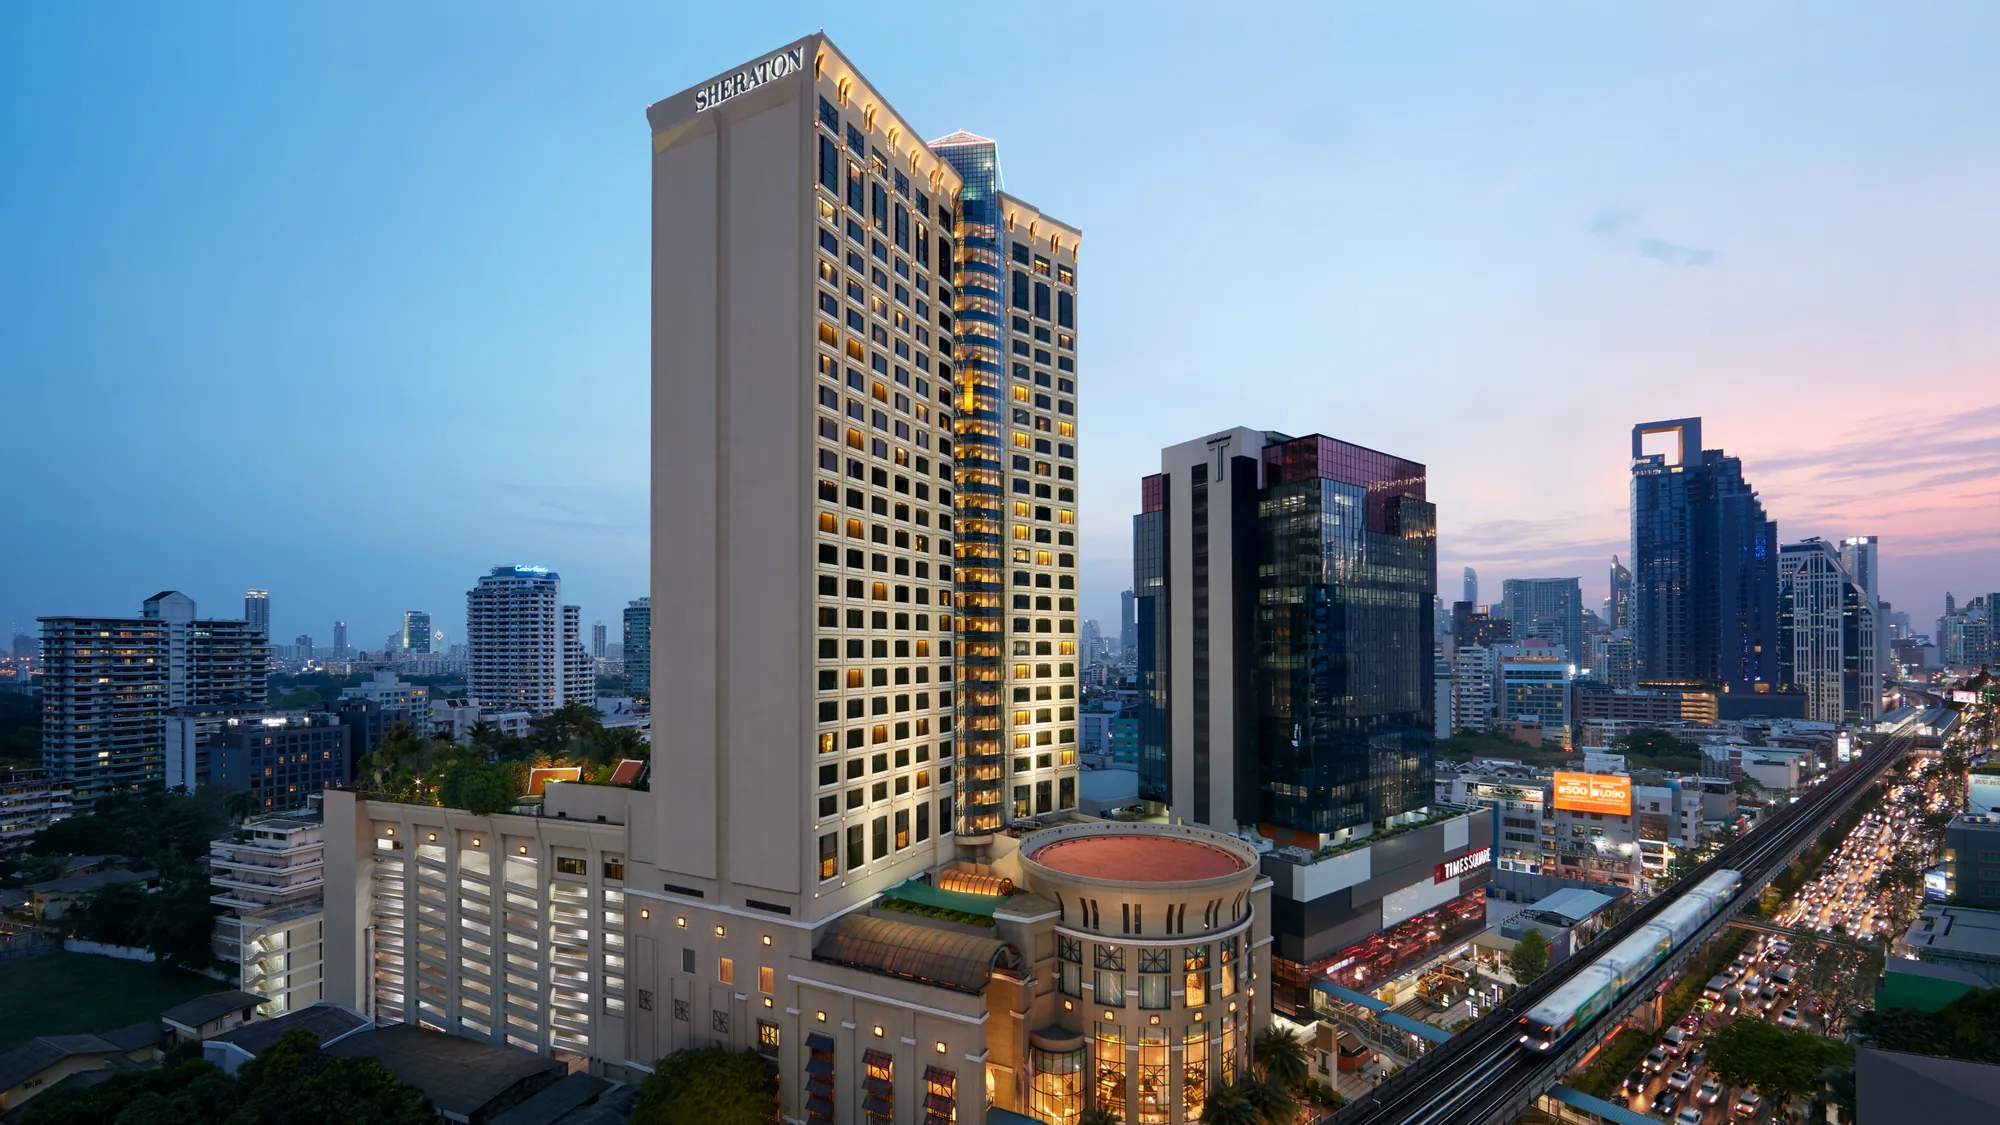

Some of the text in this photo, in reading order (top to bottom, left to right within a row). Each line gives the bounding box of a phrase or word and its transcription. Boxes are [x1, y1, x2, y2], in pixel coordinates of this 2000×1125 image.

[695, 46, 803, 113] SHERATON
[1444, 857, 1468, 879] TIMES
[1469, 847, 1491, 869] SQUARE
